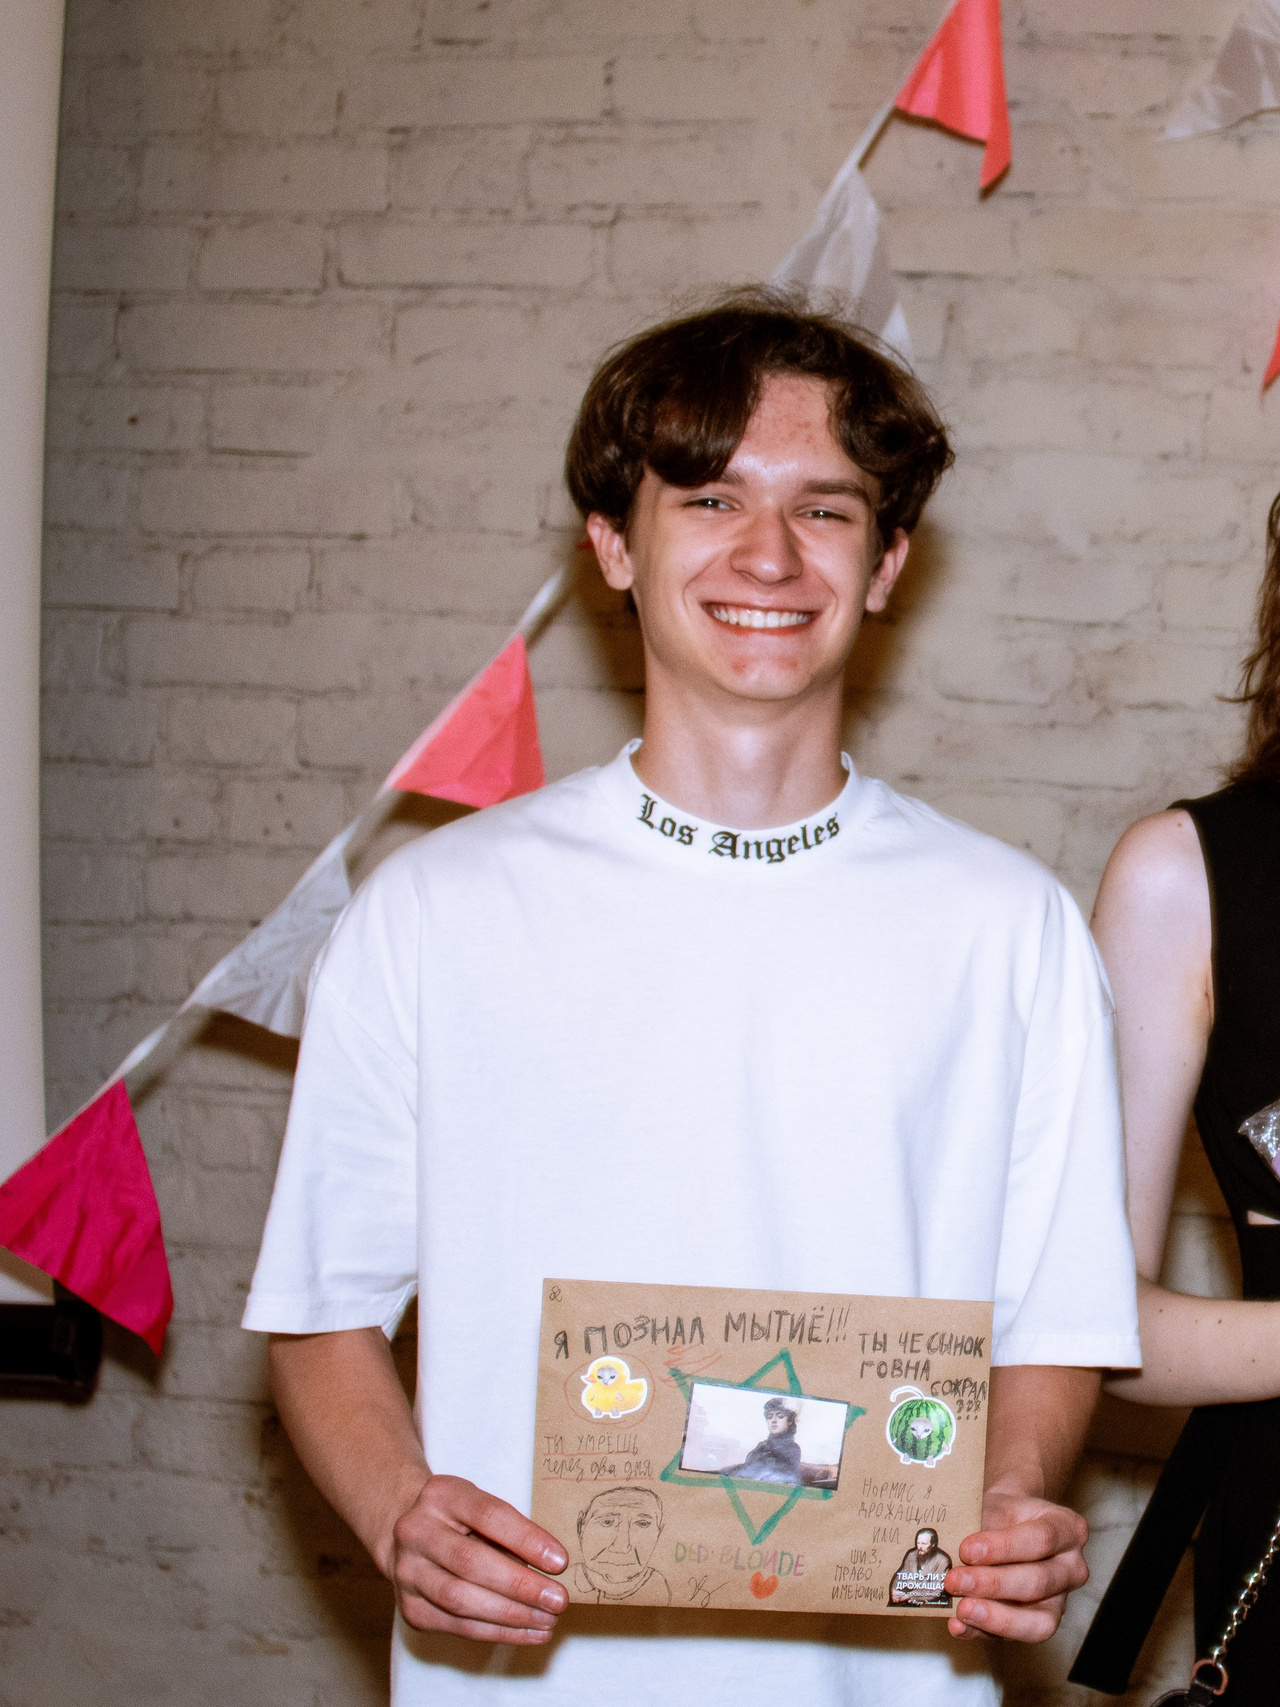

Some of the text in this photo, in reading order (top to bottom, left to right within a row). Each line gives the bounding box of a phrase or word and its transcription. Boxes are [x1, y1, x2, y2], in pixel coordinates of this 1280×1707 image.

[636, 793, 841, 864] Los Angeles
[553, 1302, 852, 1360] Я ПОЗНАЛ МЫТИЁ!!!
[858, 1330, 987, 1358] ТЫ ЧЕ СЫНОК
[860, 1358, 931, 1381] ГОВНА
[930, 1376, 988, 1400] СОЖРАЛ
[543, 1434, 564, 1454] ТЫ
[543, 1456, 655, 1483] через два дня
[858, 1501, 949, 1526] ДРОЖАЩИЙ
[872, 1526, 901, 1545] ИЛИ
[834, 1564, 873, 1582] ПРАВО
[896, 1571, 925, 1581] ТВАРЬ
[926, 1572, 939, 1581] ЛИ
